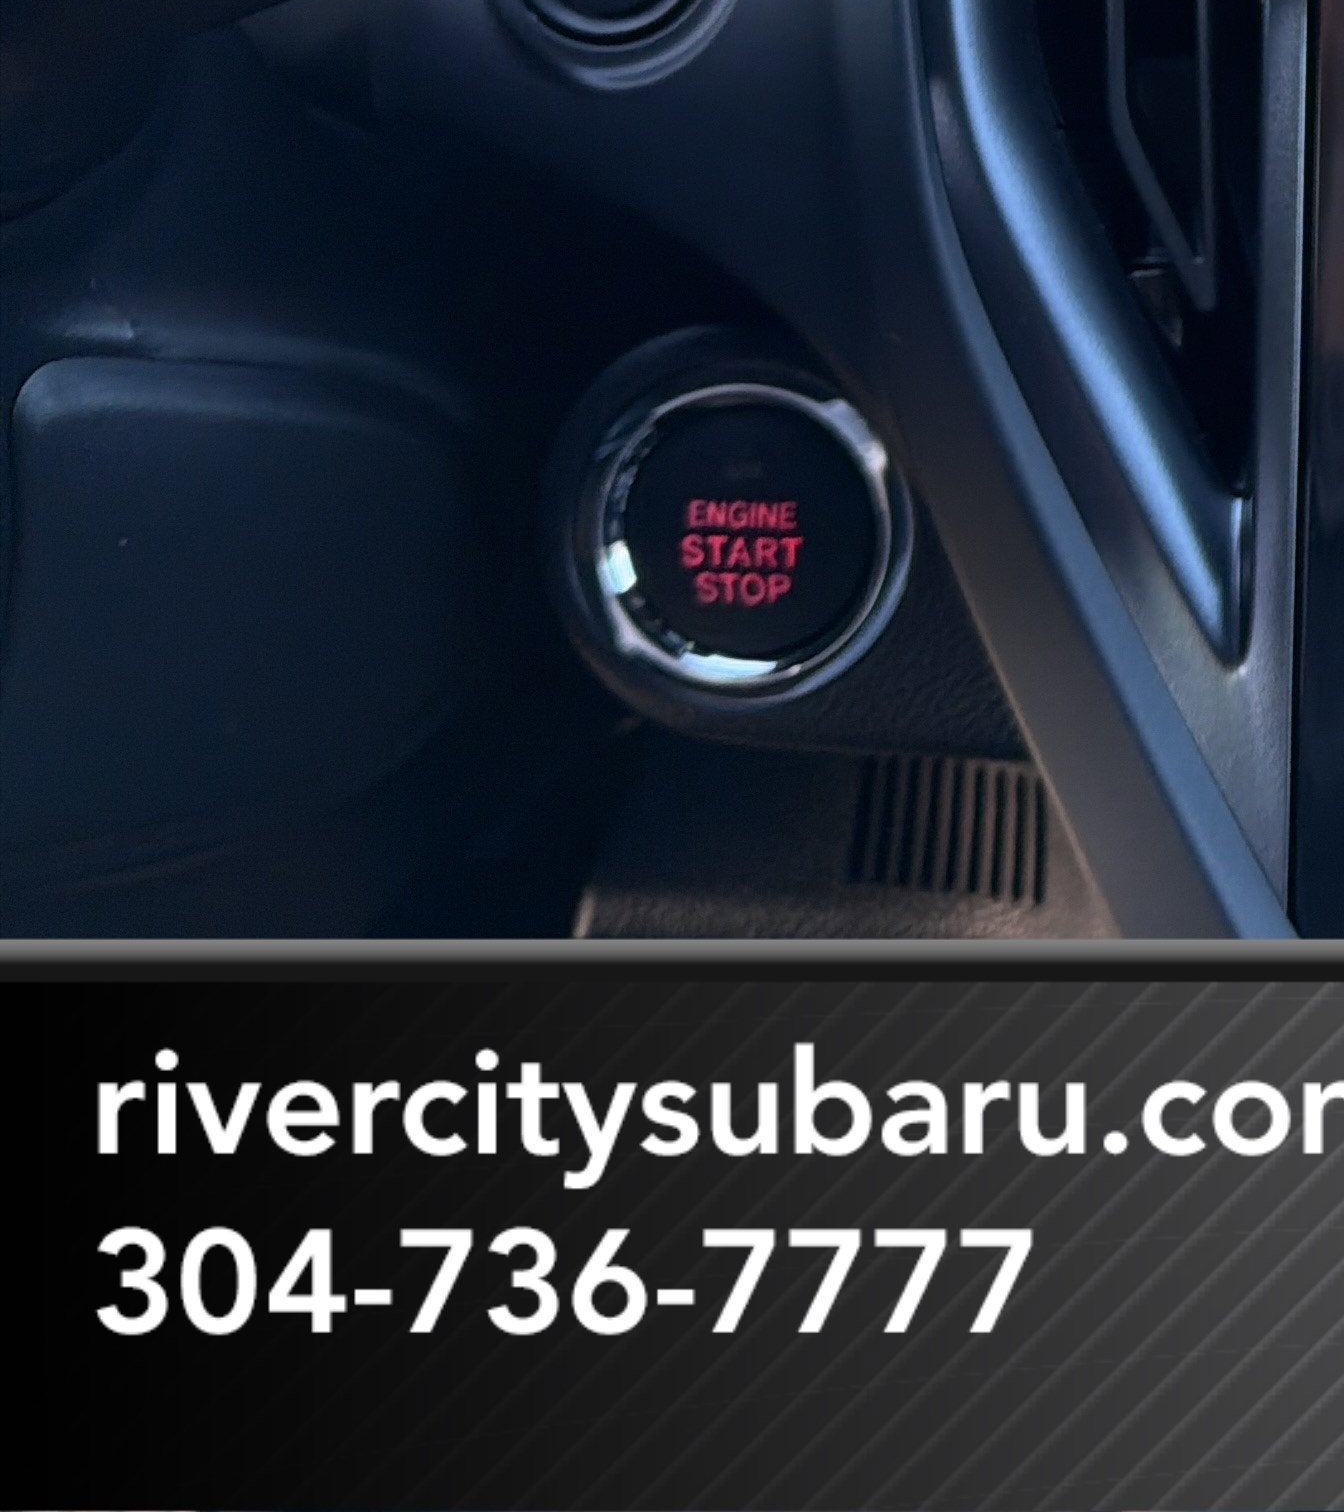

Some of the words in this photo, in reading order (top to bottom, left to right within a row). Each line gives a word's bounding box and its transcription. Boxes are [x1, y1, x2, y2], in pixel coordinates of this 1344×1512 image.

[686, 498, 799, 530] ENGINE
[680, 534, 803, 569] START
[694, 571, 793, 607] STOP
